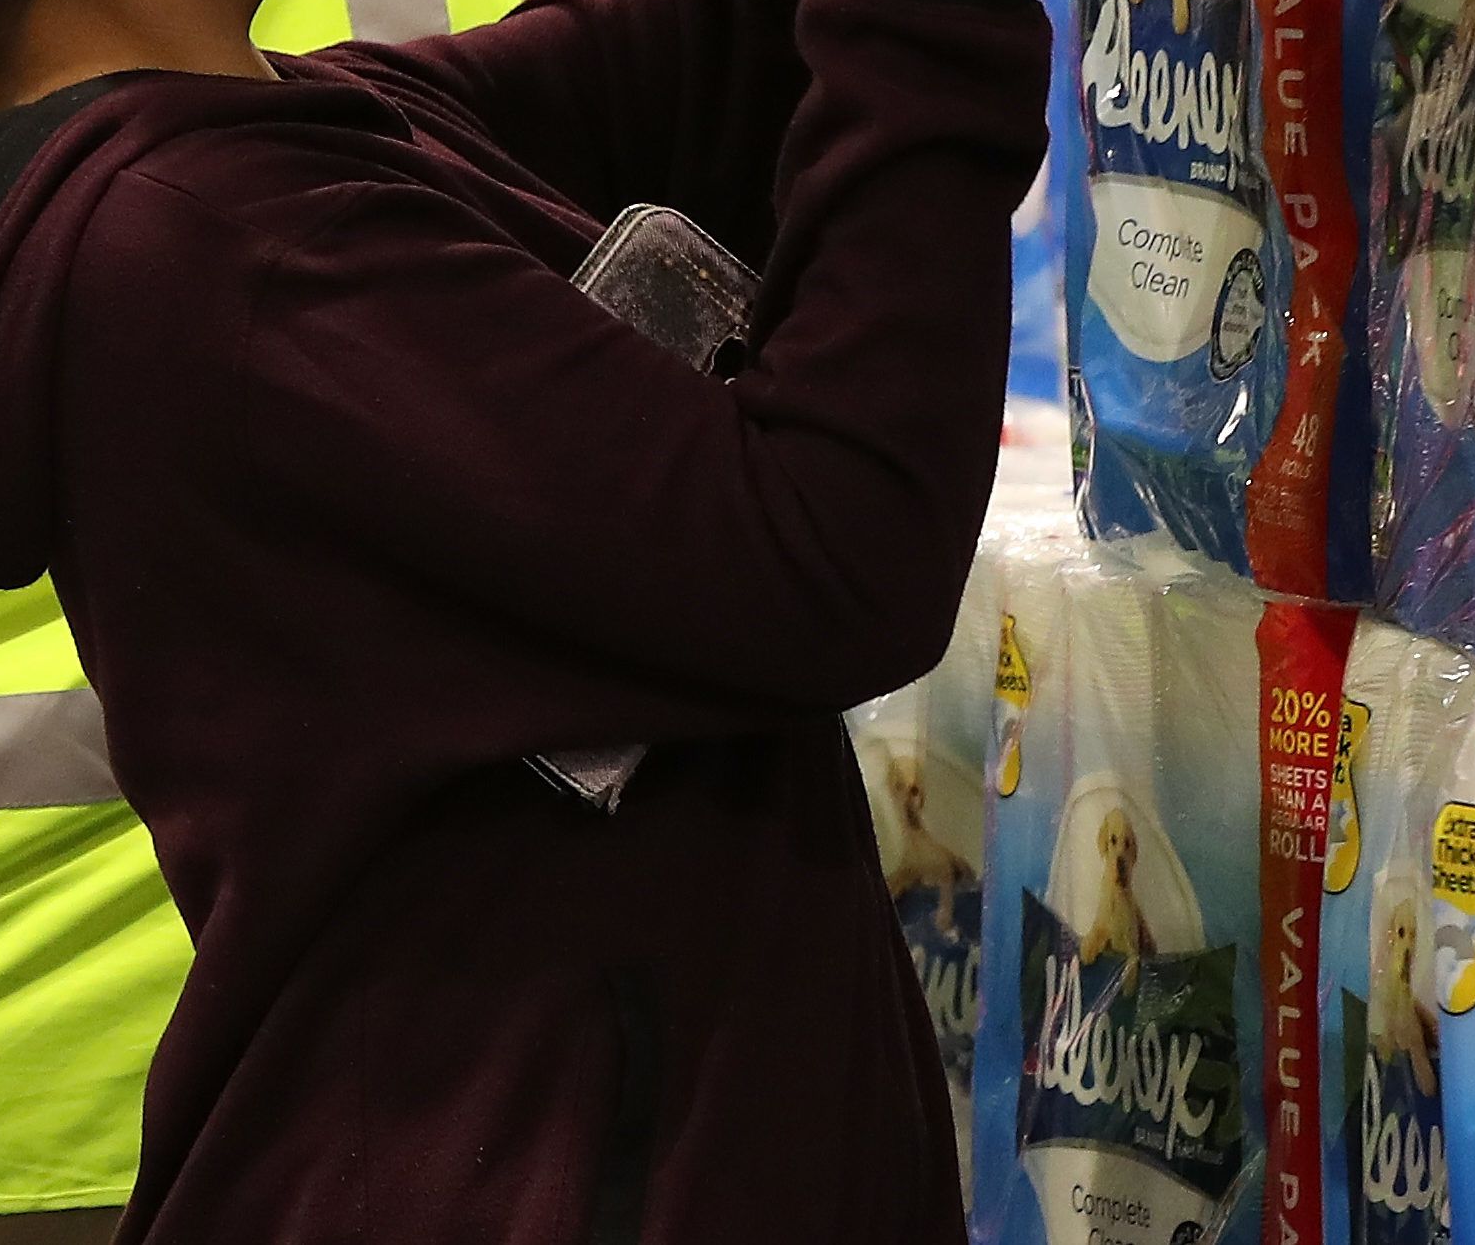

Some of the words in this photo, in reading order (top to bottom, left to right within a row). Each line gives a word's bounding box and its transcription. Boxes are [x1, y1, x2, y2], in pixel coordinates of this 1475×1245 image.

[1129, 260, 1190, 301] Clean
[1283, 192, 1325, 369] PAK
[1291, 411, 1321, 458] 48
[1269, 687, 1332, 728] 20%
[1269, 727, 1330, 758] MORE
[1269, 762, 1329, 790] SHEETS
[1270, 787, 1306, 811] THAN
[1310, 792, 1328, 813] A
[1268, 829, 1326, 864] ROLL
[1276, 905, 1306, 1139] VALUE
[1071, 1183, 1153, 1229] Complete
[1276, 1170, 1302, 1245] PA
